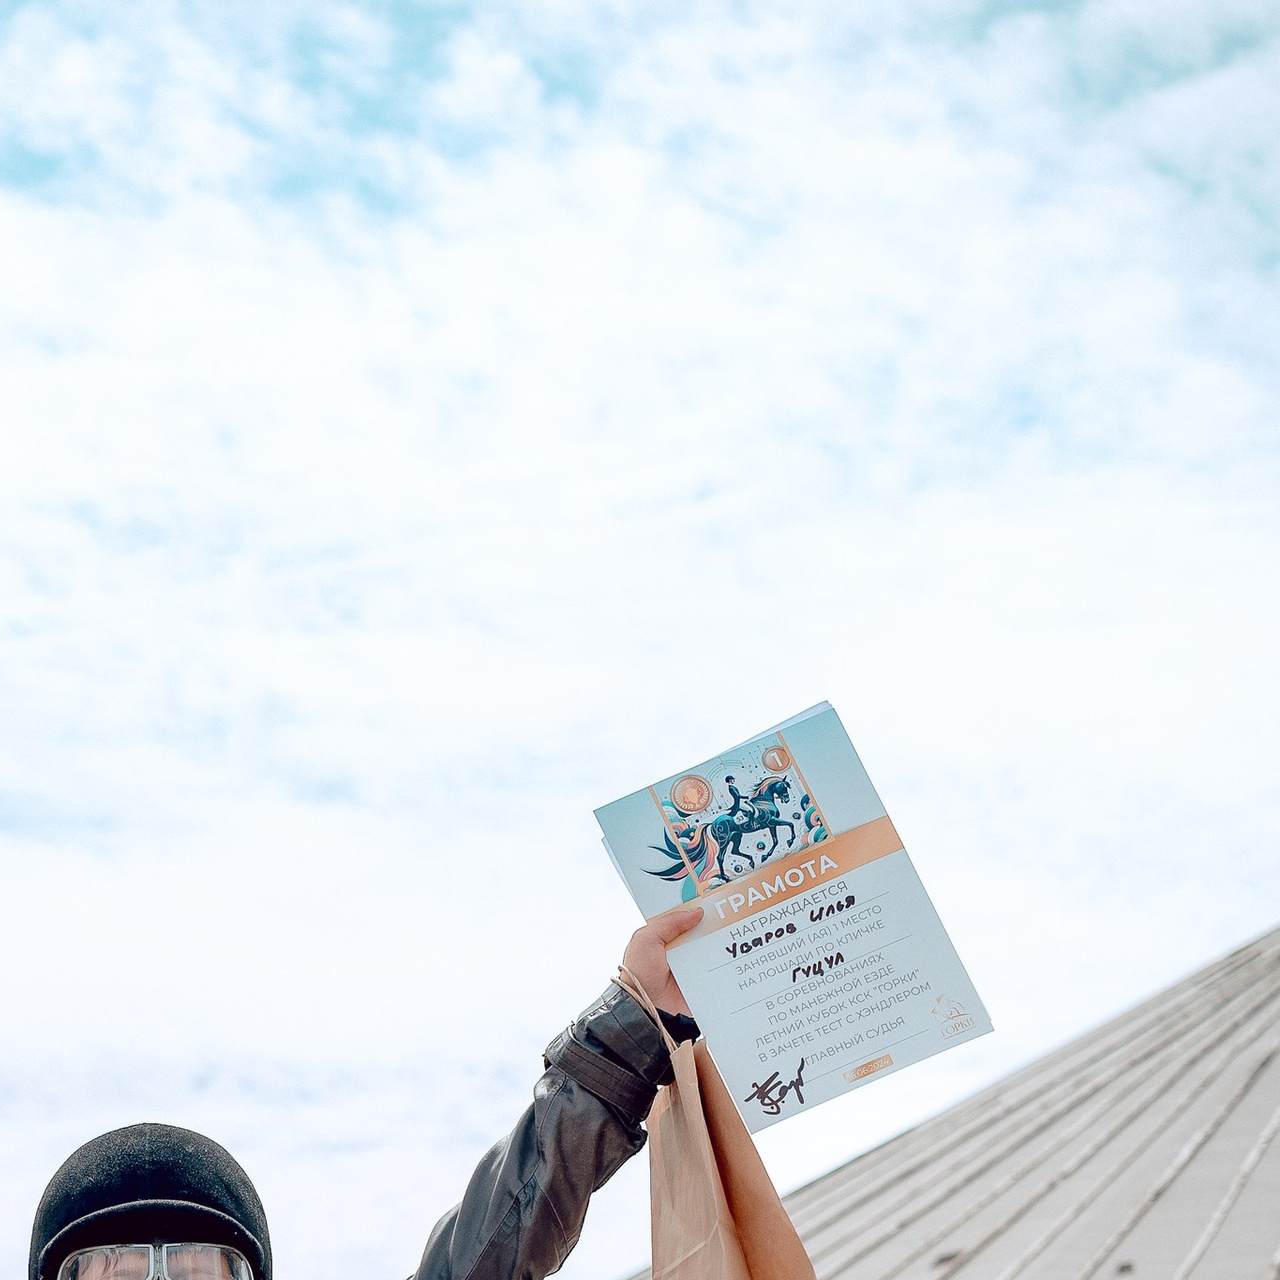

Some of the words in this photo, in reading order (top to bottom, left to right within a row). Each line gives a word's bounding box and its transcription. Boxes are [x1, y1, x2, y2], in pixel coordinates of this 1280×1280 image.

[771, 752, 783, 769] 1
[714, 851, 840, 920] ГРАМОТА
[730, 881, 849, 941] НАГРАЖДАЕТСЯ
[736, 936, 807, 976] ЗАНЯВШИЙ
[808, 926, 833, 945] (АЯ)
[833, 924, 839, 933] 1
[840, 904, 883, 930] МЕСТО
[738, 976, 757, 991] НА
[757, 950, 815, 982] ЛОШАДИ
[816, 942, 836, 957] ПО
[837, 919, 885, 947] КЛИЧКЕ
[755, 1018, 806, 1049] ЛЕТНИЙ
[807, 1001, 848, 1026] КУБОК
[849, 990, 873, 1007] КСК
[874, 969, 922, 996] "ГОРКИ"
[766, 1000, 776, 1011] В
[776, 952, 885, 1006] СОРЕВНОВАНИЯХ
[768, 1011, 789, 1026] ПО
[790, 977, 863, 1016] МАНЕЖНОЙ
[864, 964, 896, 984] ЕЗДЕ
[759, 1052, 769, 1063] В
[769, 1032, 814, 1059] ЗАЧЕТЕ
[814, 1019, 845, 1039] ТЕСТ
[845, 1014, 855, 1025] С
[856, 982, 932, 1022] ХЭНДЛЕРОМ
[804, 1033, 865, 1067] ГЛАВНЫЙ
[865, 1016, 906, 1041] СУДЬЯ
